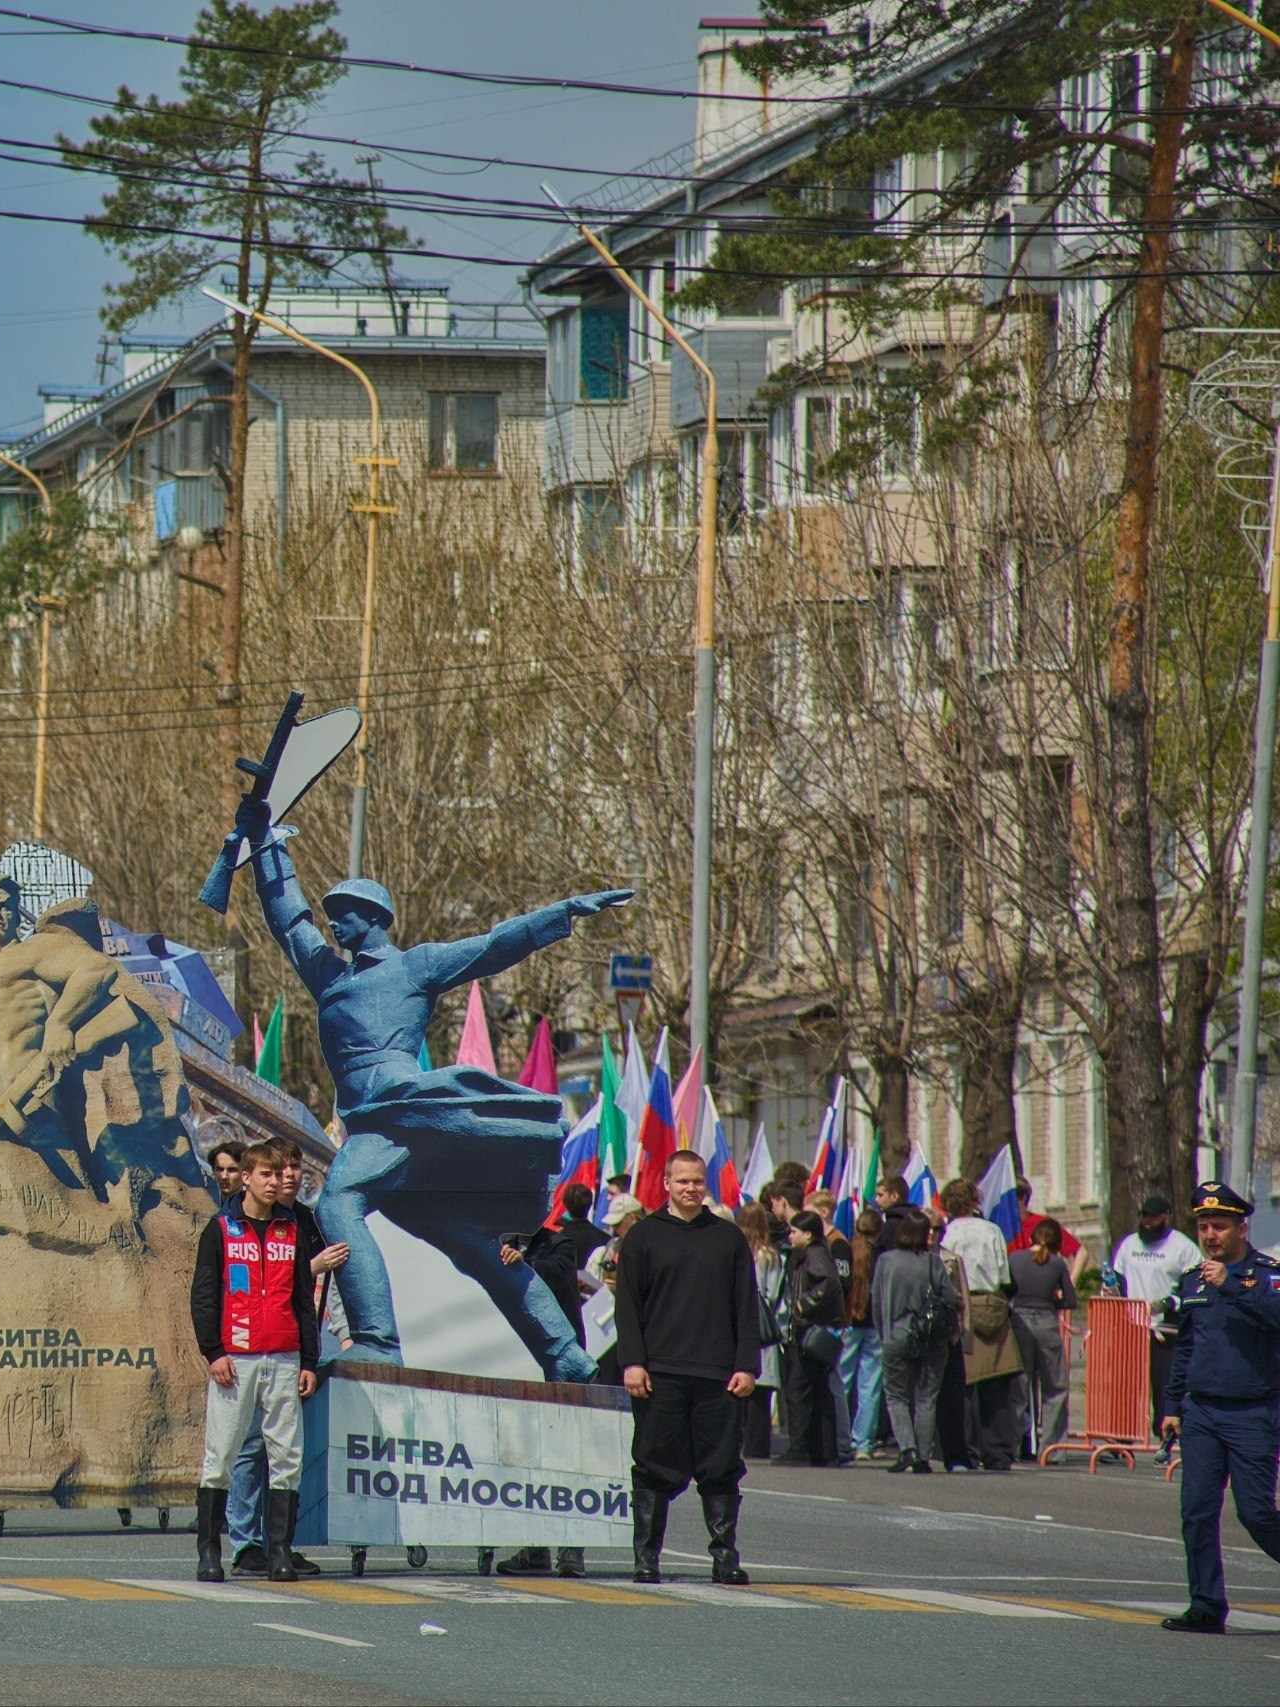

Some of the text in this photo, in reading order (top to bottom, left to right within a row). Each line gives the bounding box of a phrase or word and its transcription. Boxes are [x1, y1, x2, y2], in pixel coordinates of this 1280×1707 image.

[346, 1433, 474, 1470] БИТВА
[346, 1467, 629, 1518] ПОД МОСКВОЙ
